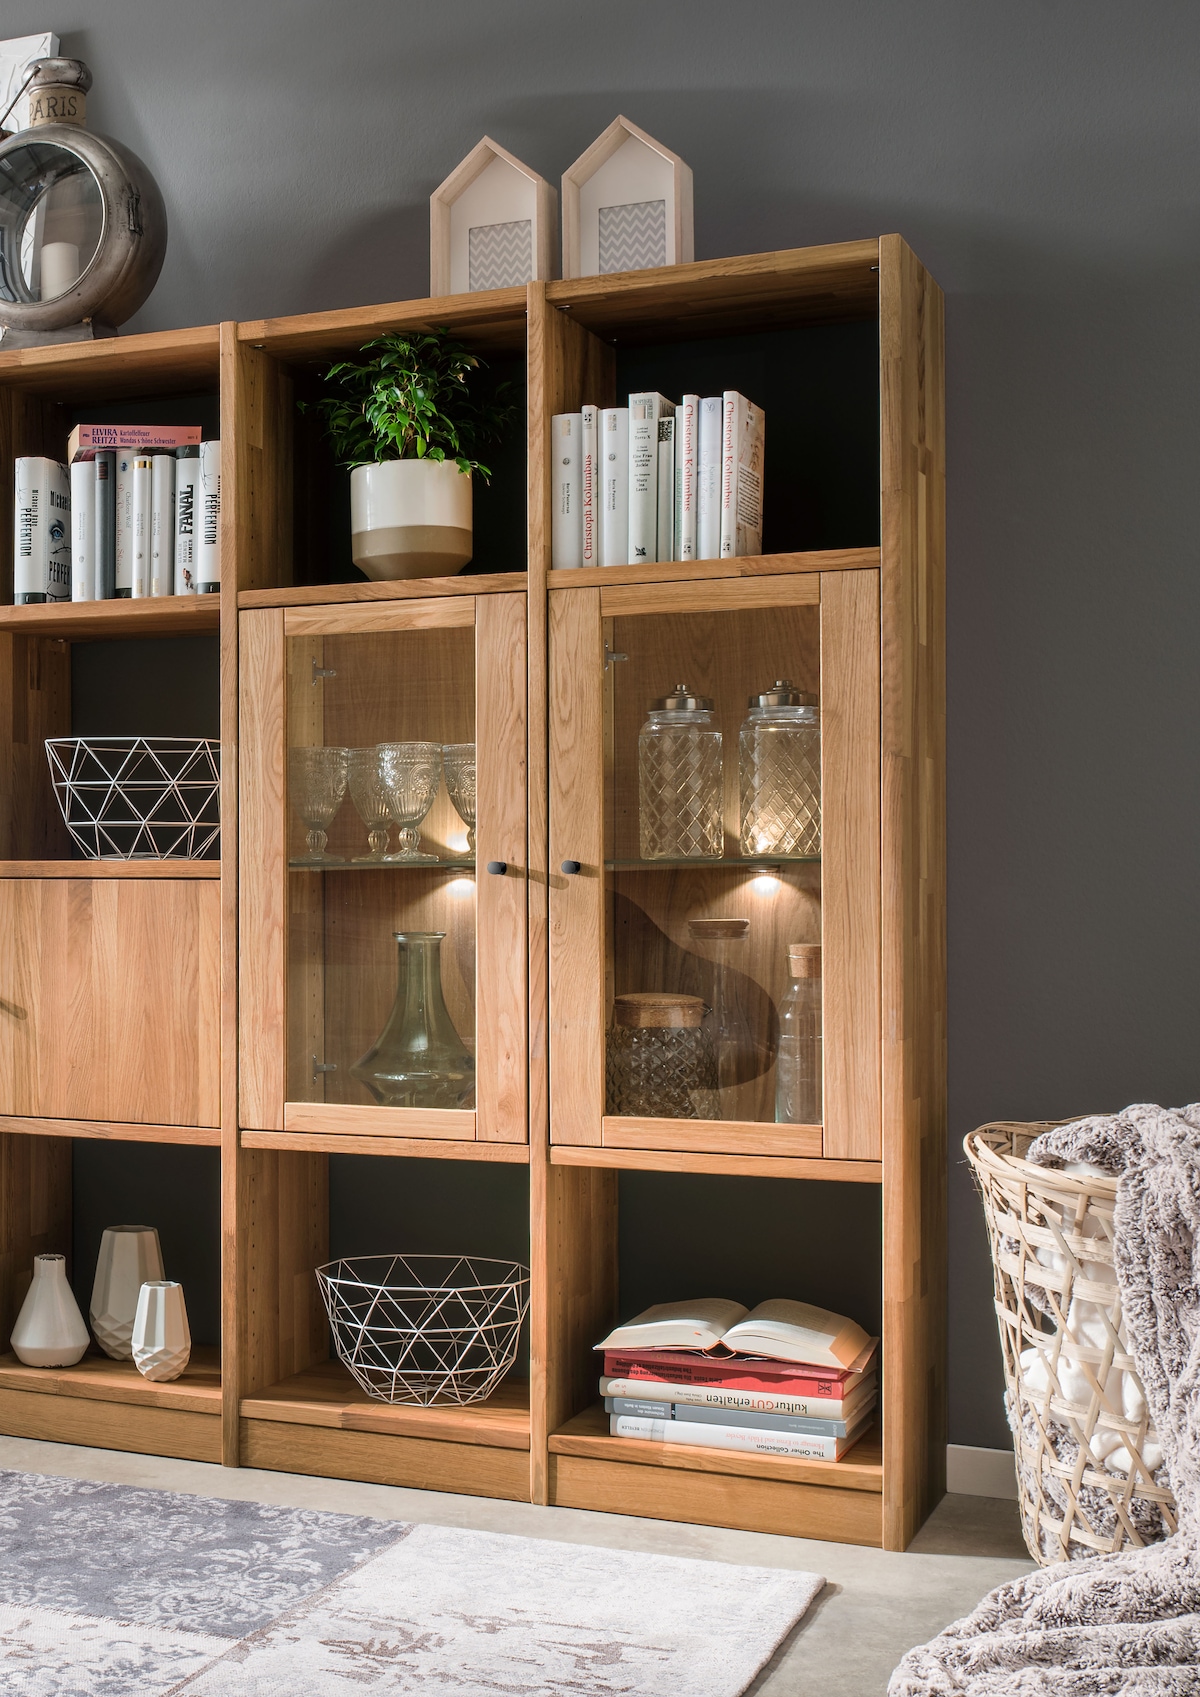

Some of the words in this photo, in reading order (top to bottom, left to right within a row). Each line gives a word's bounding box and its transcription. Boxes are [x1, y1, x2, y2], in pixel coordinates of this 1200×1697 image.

[92, 428, 118, 437] ELVIRA
[92, 436, 117, 445] REITZE
[684, 403, 694, 456] Christoph
[724, 401, 734, 453] Christoph
[584, 454, 593, 507] Kolumbus
[684, 458, 693, 512] Kolumbus
[723, 455, 733, 510] Kolumbus
[20, 507, 32, 557] PERFEKTION
[179, 484, 194, 536] FANAL
[204, 494, 218, 545] PERFEKTION
[584, 509, 594, 560] Christoph
[706, 1394, 808, 1414] kulturGUTerhalten
[756, 1444, 789, 1453] Collection
[791, 1448, 811, 1456] Other
